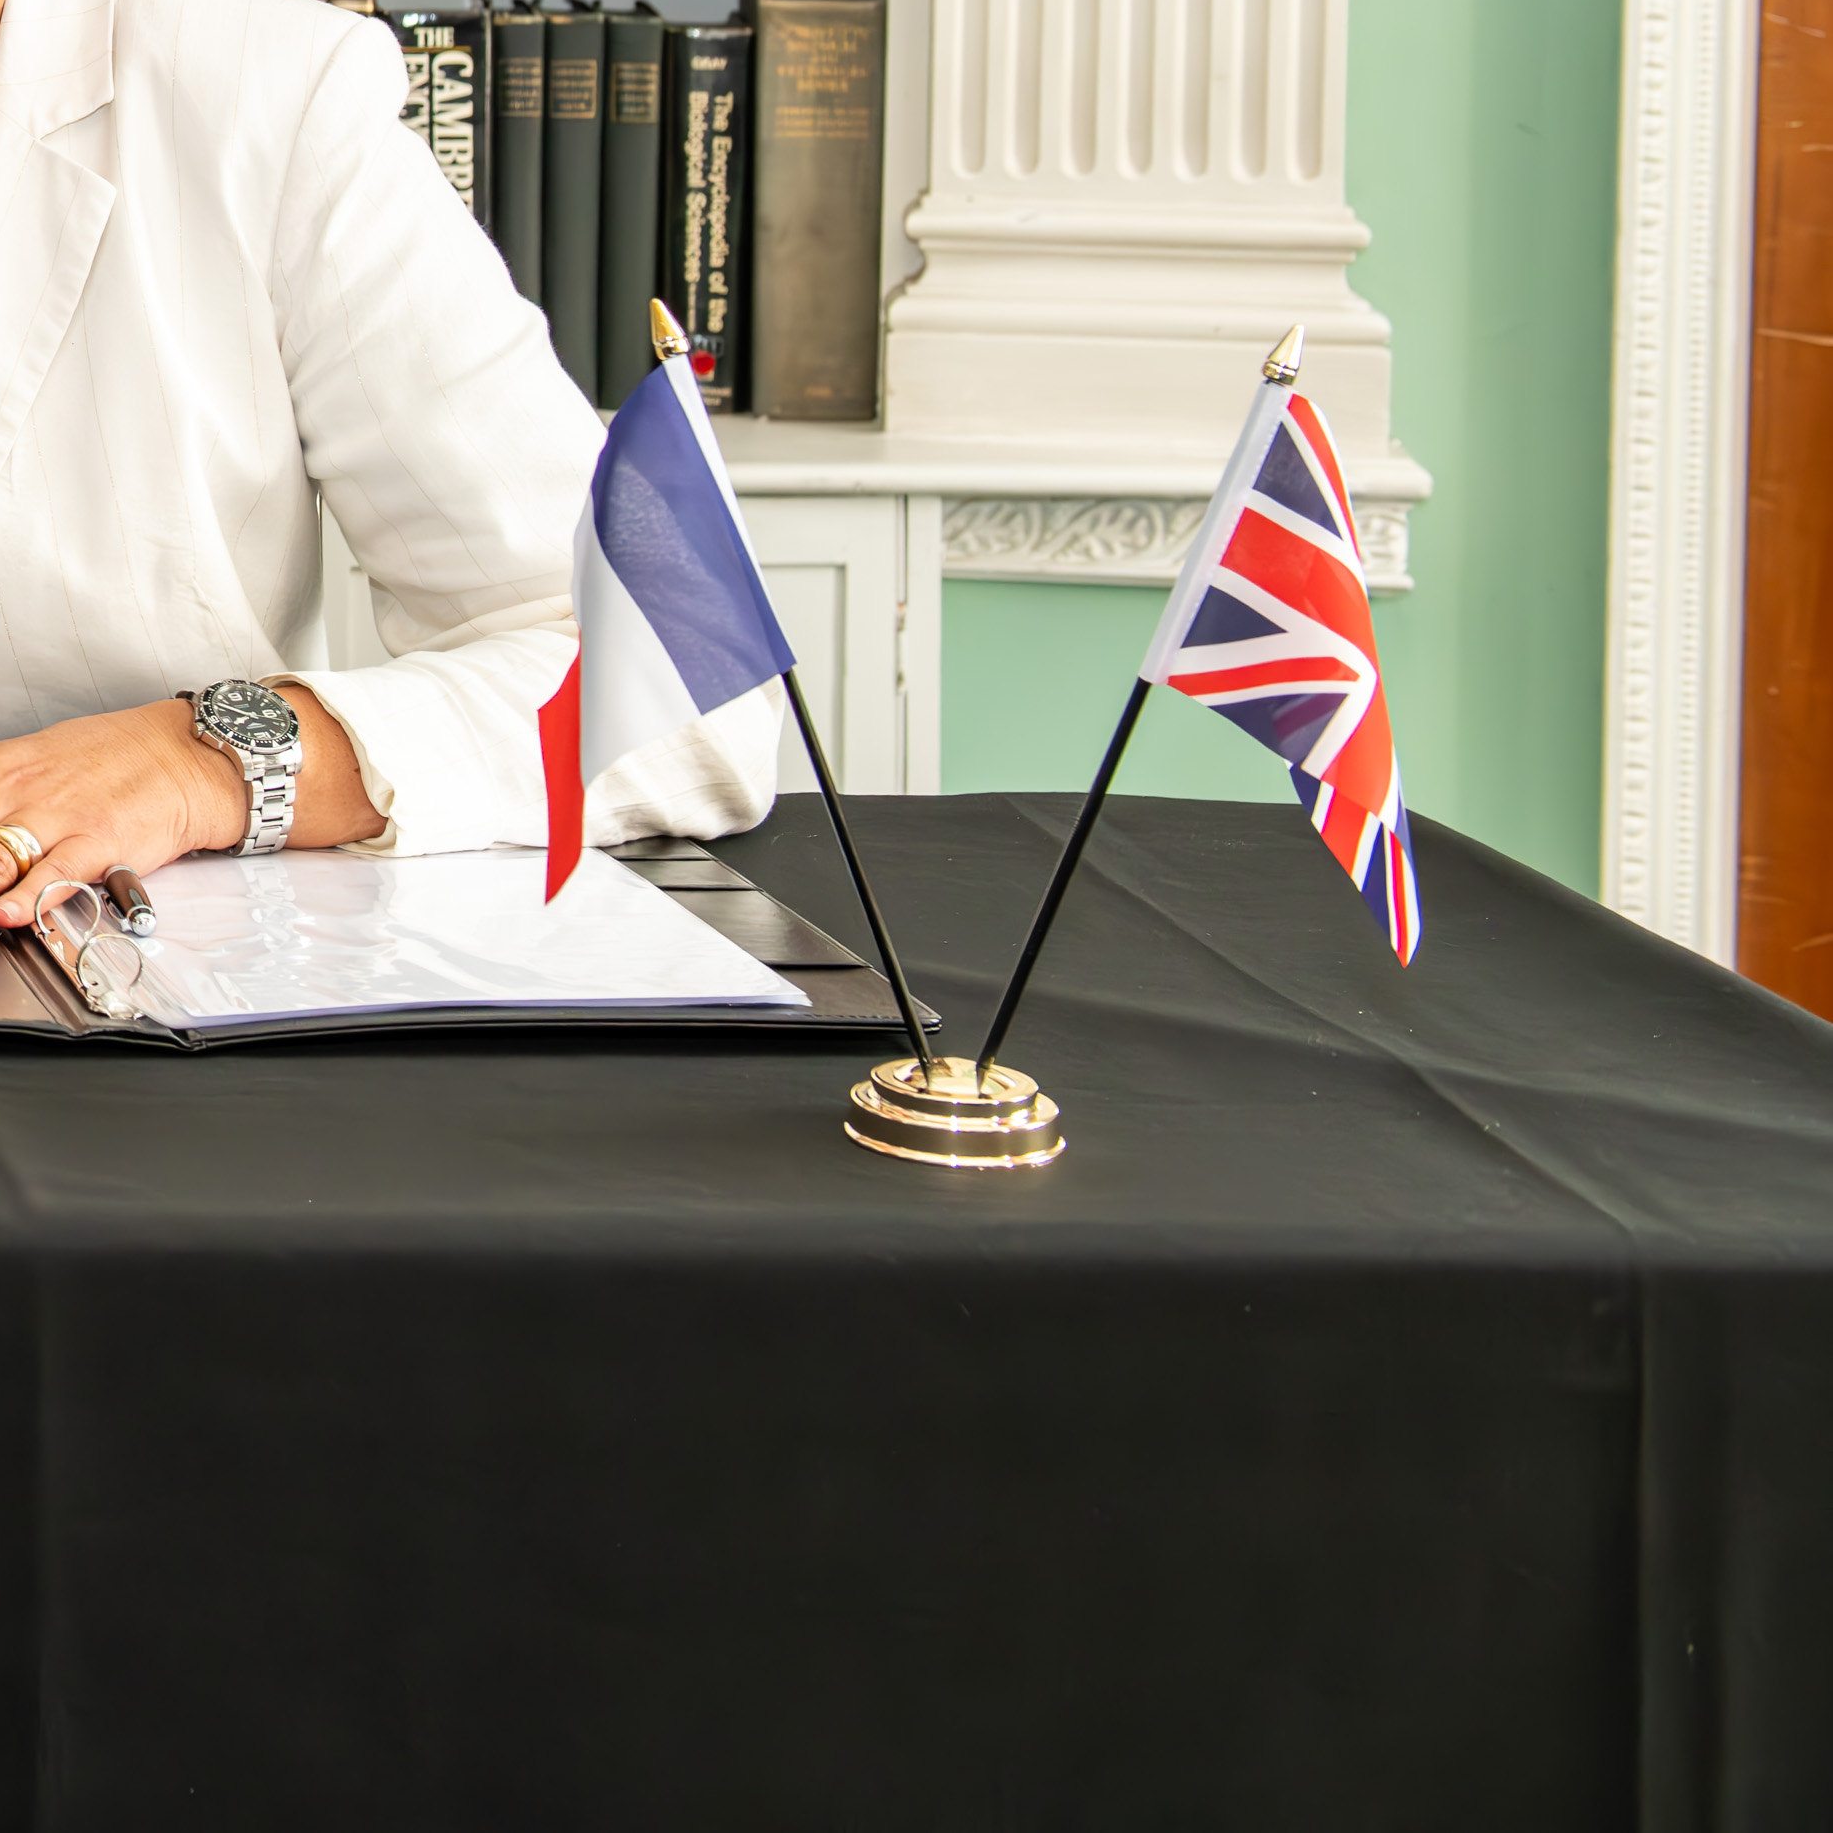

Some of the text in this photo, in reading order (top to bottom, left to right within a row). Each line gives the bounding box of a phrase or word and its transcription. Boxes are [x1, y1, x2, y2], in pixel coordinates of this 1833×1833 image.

[415, 27, 454, 48] THE
[684, 90, 709, 283] Biological Sciences
[707, 91, 733, 333] The Encyclopedia of the
